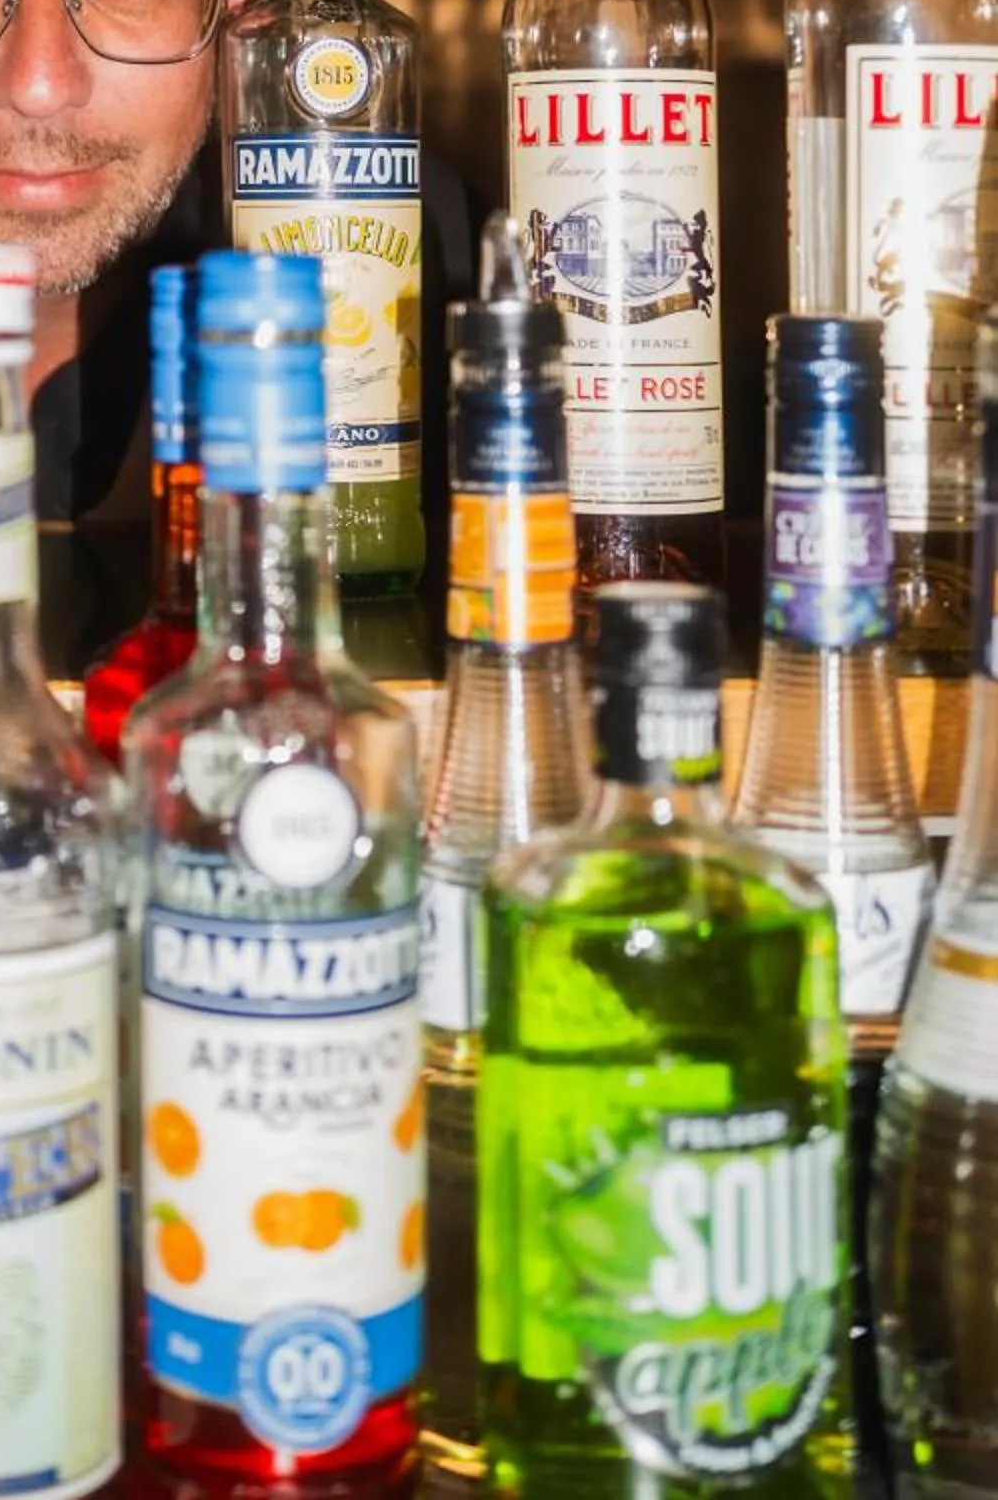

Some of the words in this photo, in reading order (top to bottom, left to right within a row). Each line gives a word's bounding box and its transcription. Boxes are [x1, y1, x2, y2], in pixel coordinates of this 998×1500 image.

[313, 64, 353, 85] 1815
[871, 72, 998, 128] LIL
[517, 93, 715, 147] LILLET
[238, 146, 419, 186] RAMAZZOTTI
[631, 338, 692, 349] FRANCE
[640, 370, 706, 401] ROSÉ
